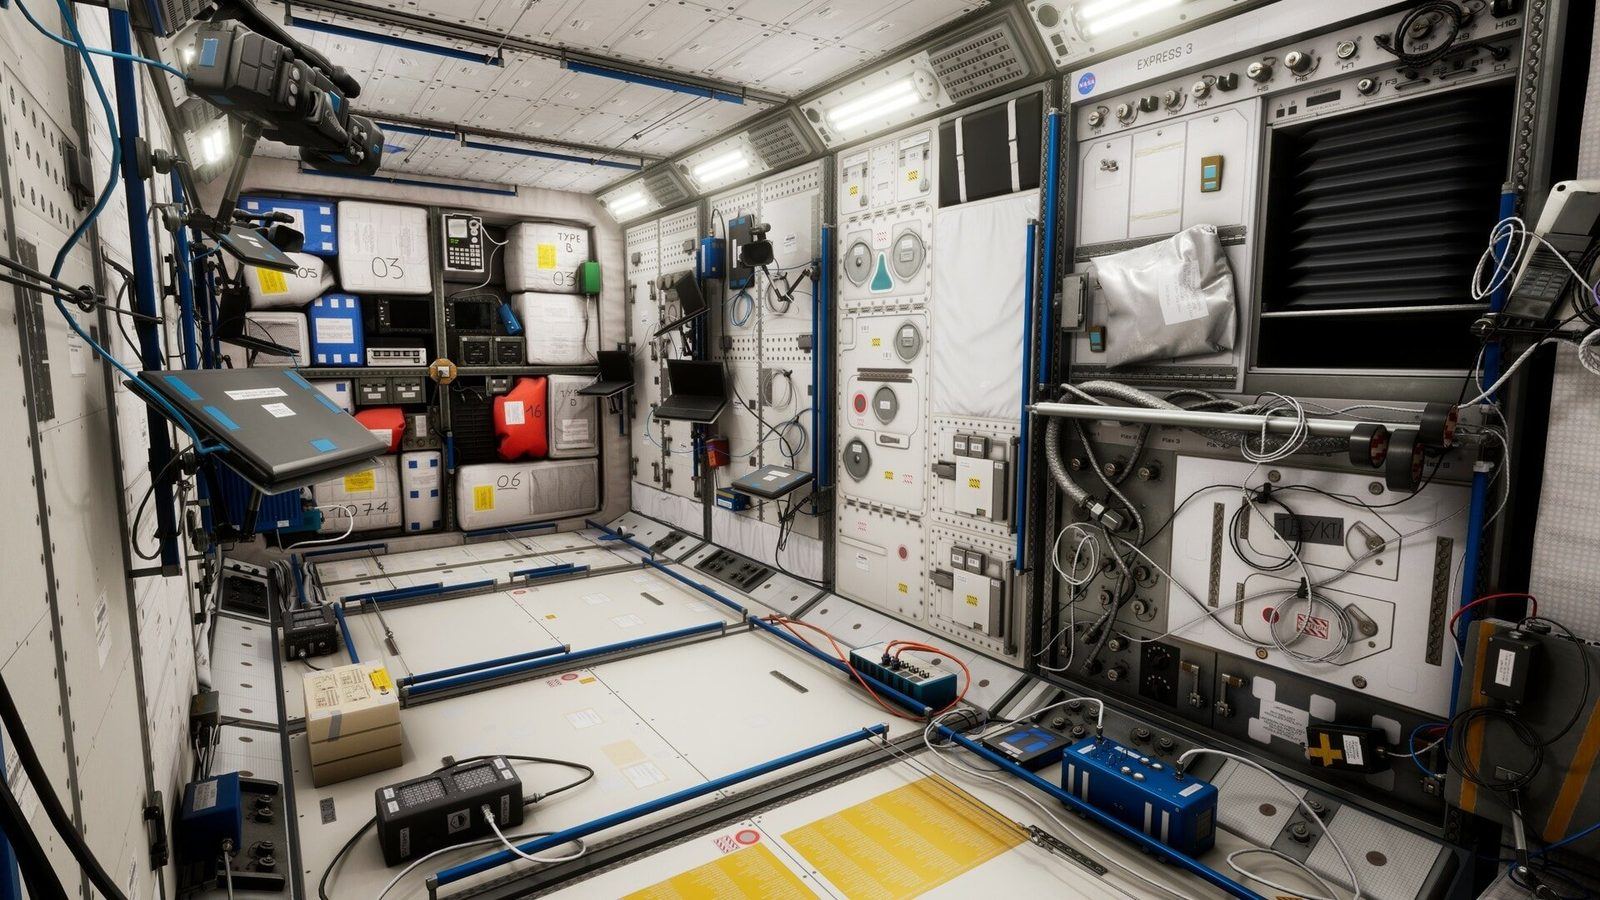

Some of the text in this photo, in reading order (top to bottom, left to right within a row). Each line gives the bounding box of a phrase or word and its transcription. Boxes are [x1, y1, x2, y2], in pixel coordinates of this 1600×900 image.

[1137, 42, 1193, 70] EXPRESS 3
[557, 232, 581, 243] TYPE
[372, 256, 404, 279] 03
[552, 271, 577, 287] 03
[525, 404, 542, 418] 16
[497, 472, 521, 488] 06
[329, 501, 388, 518] 1074
